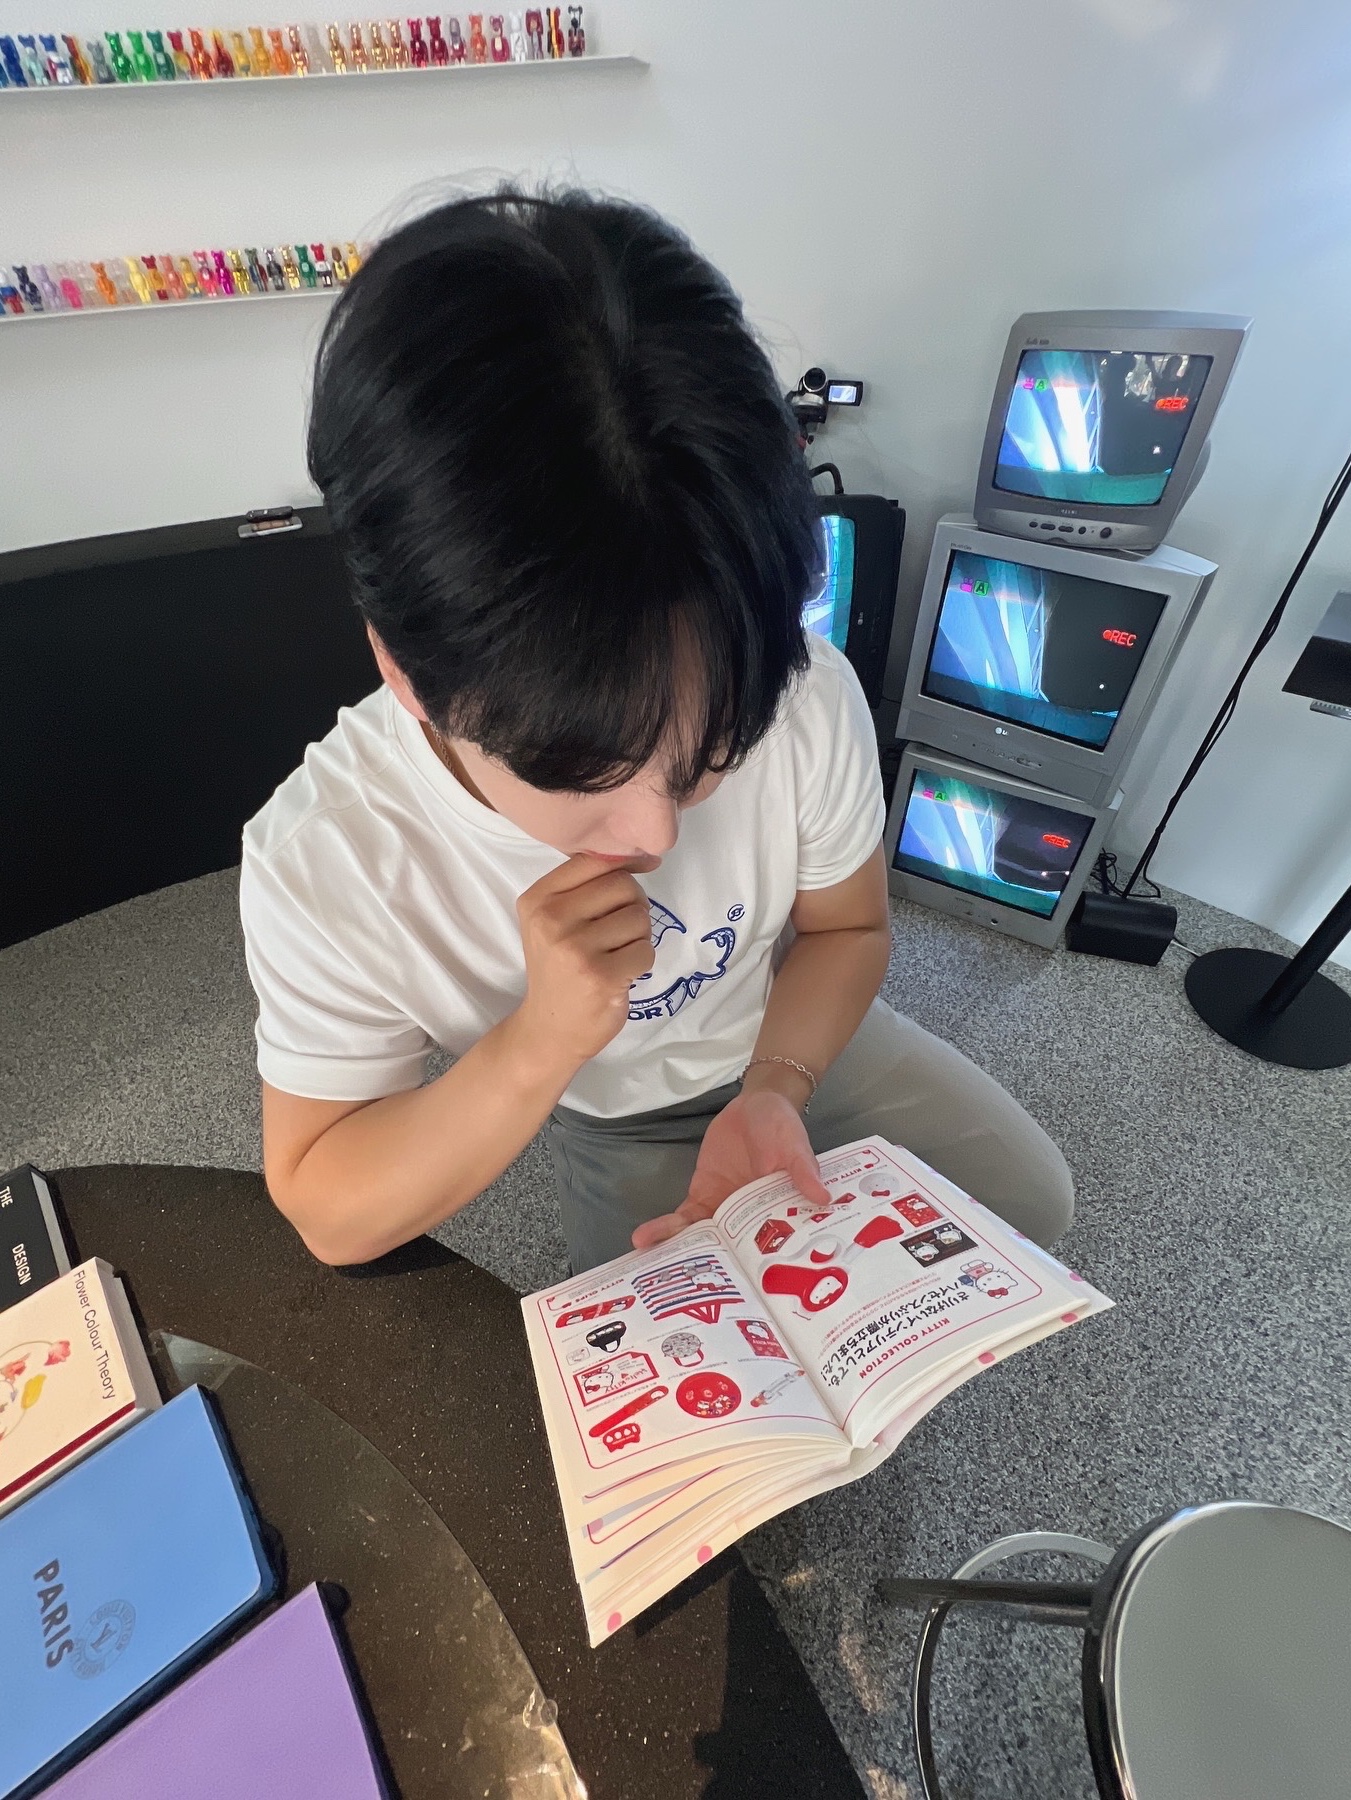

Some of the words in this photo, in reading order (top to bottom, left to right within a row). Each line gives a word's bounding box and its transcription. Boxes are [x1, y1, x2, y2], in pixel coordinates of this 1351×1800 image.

[1163, 396, 1189, 410] REC
[1110, 629, 1137, 647] REC
[1049, 834, 1072, 848] REC
[840, 1168, 863, 1181] KITTY
[0, 1185, 13, 1208] THE
[12, 1243, 32, 1285] DESIGN
[601, 1278, 625, 1291] KITTY
[575, 1288, 598, 1303] CLIPS
[73, 1269, 90, 1310] Flower
[84, 1309, 101, 1351] Colour
[96, 1350, 116, 1400] Theory
[922, 1317, 950, 1338] KITTY
[858, 1333, 919, 1379] COLLECTION
[33, 1558, 74, 1669] PARIS
